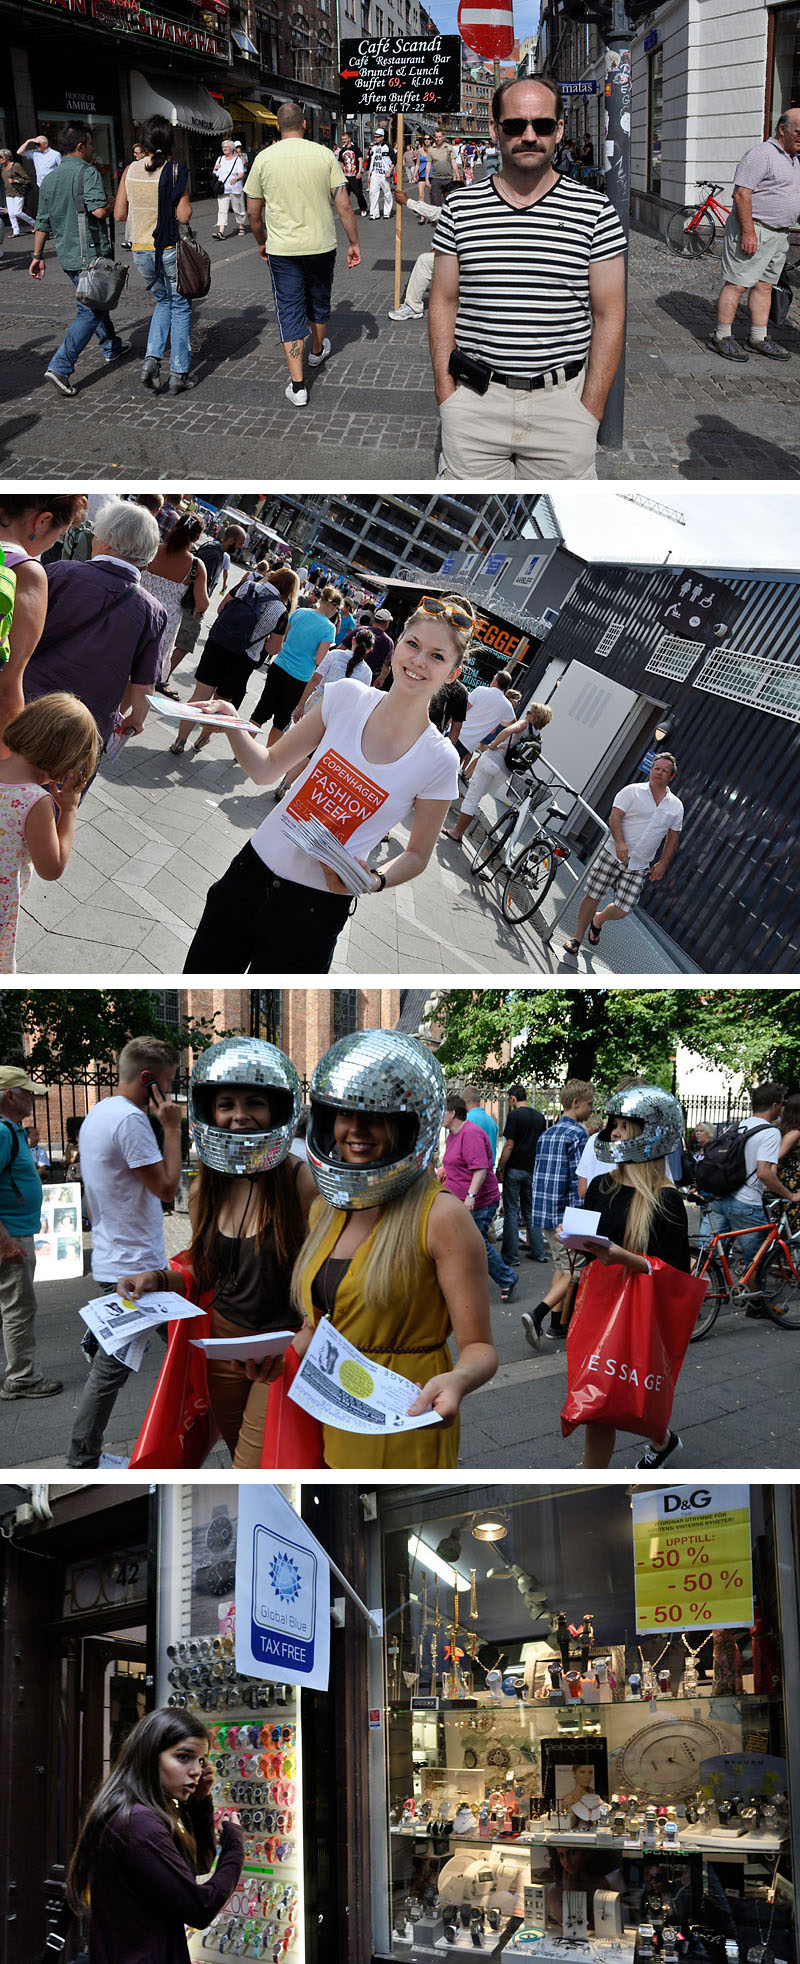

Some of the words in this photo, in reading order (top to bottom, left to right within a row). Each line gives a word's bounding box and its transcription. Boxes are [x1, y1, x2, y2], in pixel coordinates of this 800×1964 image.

[137, 13, 219, 55] SHANGHAI
[358, 37, 391, 58] Café
[392, 35, 442, 54] Scandi
[349, 55, 369, 68] Café
[376, 55, 425, 66] Restaurant
[432, 54, 451, 64] Bar
[359, 65, 393, 77] Brunch
[396, 65, 407, 76] &
[408, 64, 439, 76] Lunch
[354, 77, 386, 91] Buffet
[562, 82, 593, 93] matas
[66, 99, 96, 111] AMBER
[358, 92, 387, 105] Aften
[388, 91, 420, 105] Buffet
[375, 103, 386, 112] fra
[322, 756, 382, 807] COPENHAGEN
[311, 768, 372, 820] FASHION
[310, 787, 352, 825] WEEK
[663, 1489, 712, 1513] D&G
[666, 1533, 715, 1547] UPPTILL:
[116, 1560, 139, 1586] 42
[683, 1572, 713, 1592] 50
[260, 1605, 288, 1626] Global
[289, 1616, 307, 1632] Blue
[654, 1604, 682, 1623] 50
[260, 1636, 281, 1656] TAX
[281, 1643, 306, 1663] FREE
